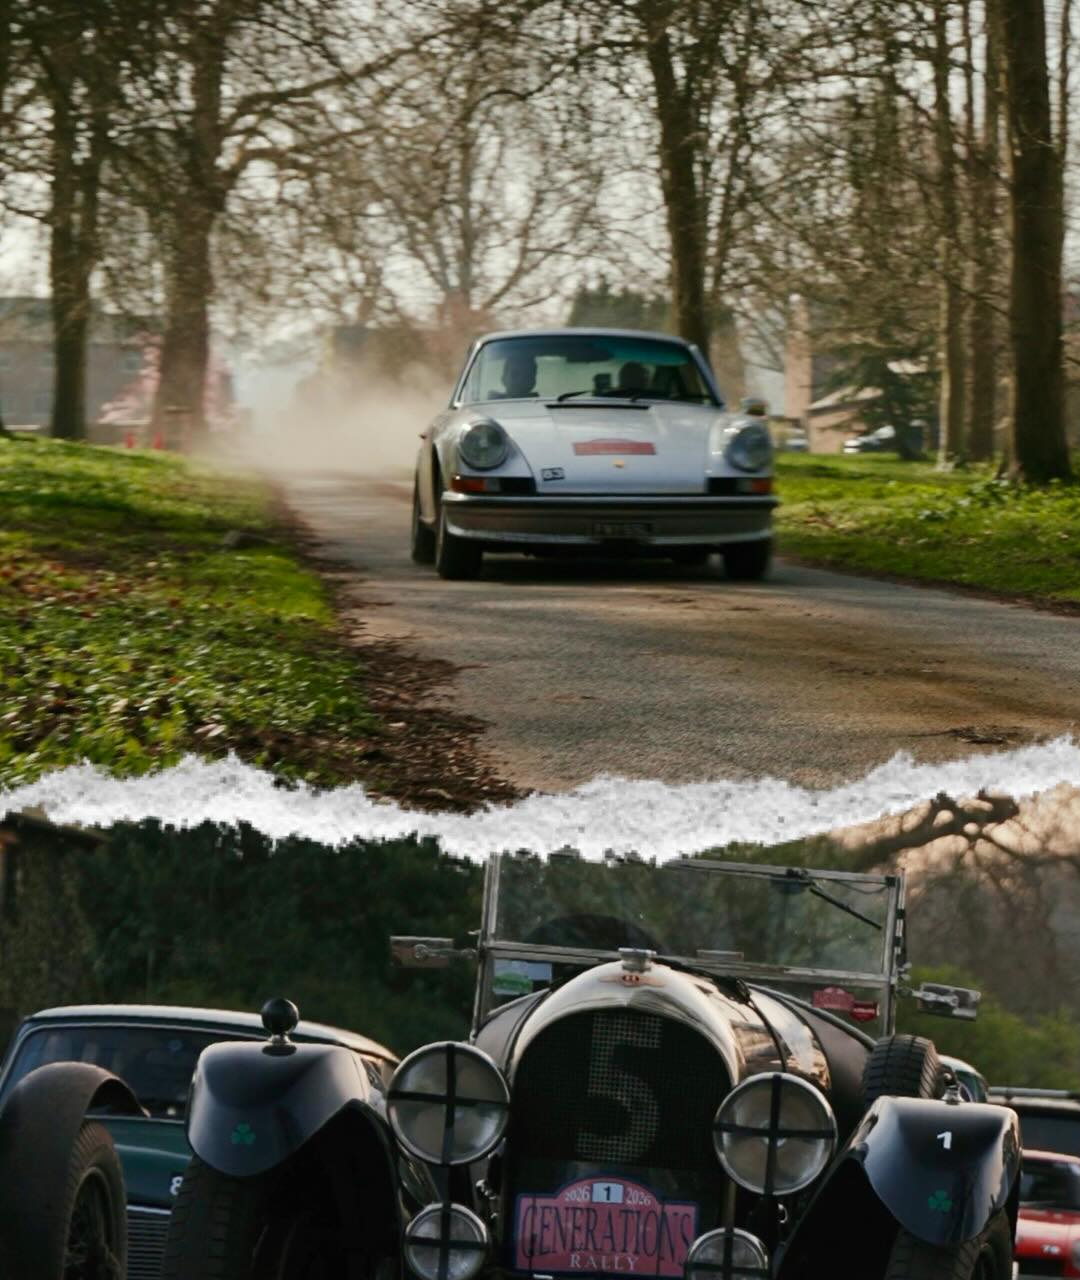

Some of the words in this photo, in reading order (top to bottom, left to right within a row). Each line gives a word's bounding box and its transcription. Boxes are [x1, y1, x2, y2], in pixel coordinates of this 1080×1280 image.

[576, 1014, 662, 1161] 5
[937, 1131, 951, 1149] 1
[565, 1186, 591, 1203] 2026
[604, 1185, 612, 1202] 1
[626, 1187, 651, 1205] 2026
[522, 1205, 691, 1266] GENERATIONS
[570, 1254, 639, 1271] RALLY
